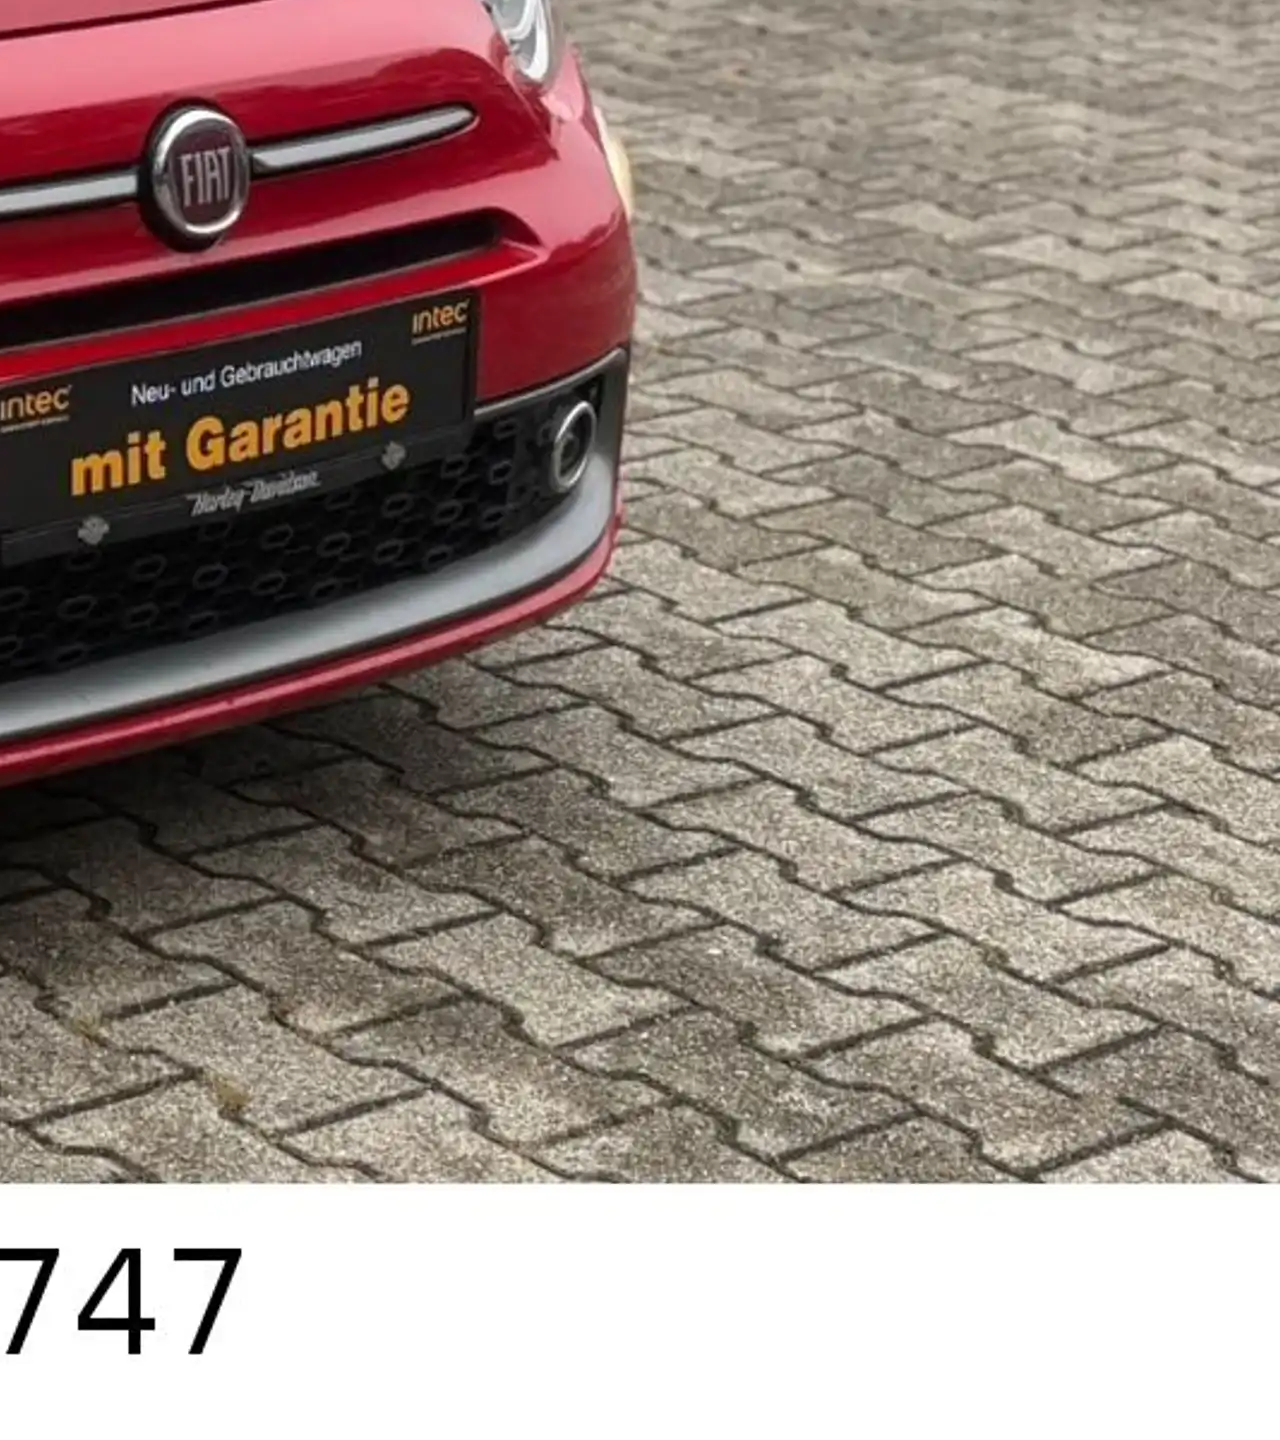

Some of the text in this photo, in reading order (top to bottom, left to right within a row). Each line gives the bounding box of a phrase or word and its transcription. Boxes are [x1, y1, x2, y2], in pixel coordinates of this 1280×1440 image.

[178, 146, 232, 208] FIAT
[131, 340, 363, 407] Neu- und Gebrauchtwagen
[70, 375, 411, 496] mit Garantie
